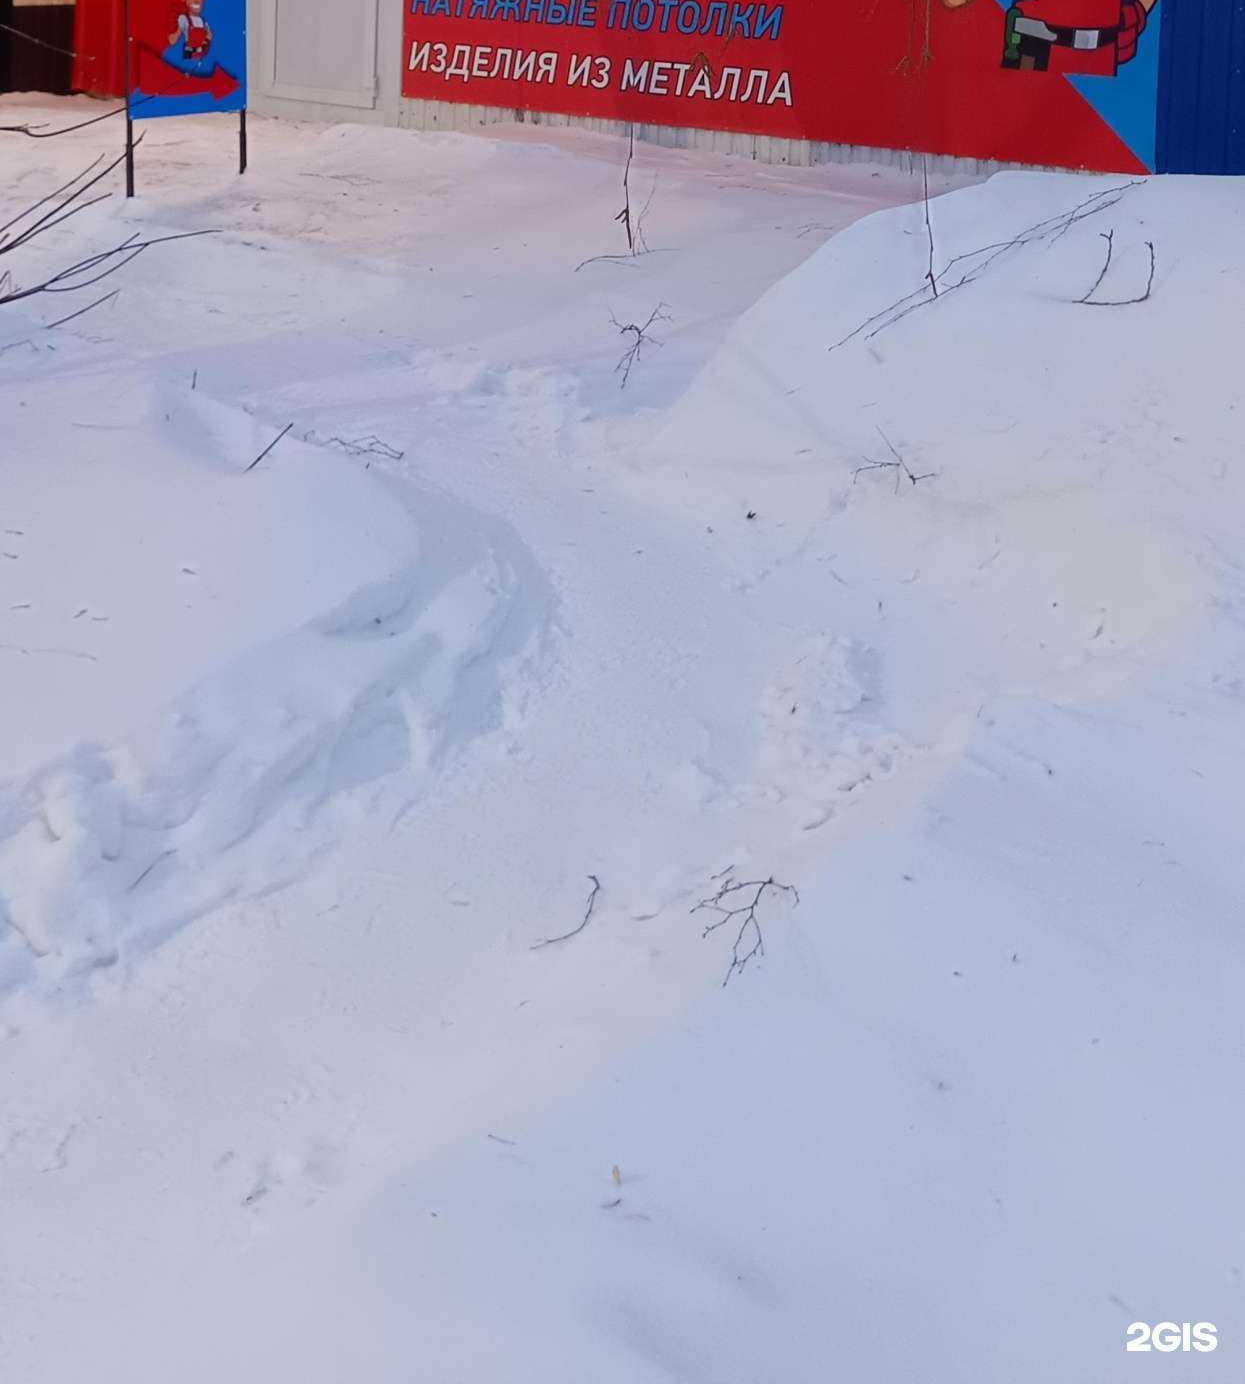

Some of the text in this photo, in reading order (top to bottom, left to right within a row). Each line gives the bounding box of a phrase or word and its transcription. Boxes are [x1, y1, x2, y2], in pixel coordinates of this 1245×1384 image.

[407, 41, 793, 107] ИЗДЕЛИЯ ИЗ МЕТАЛЛА
